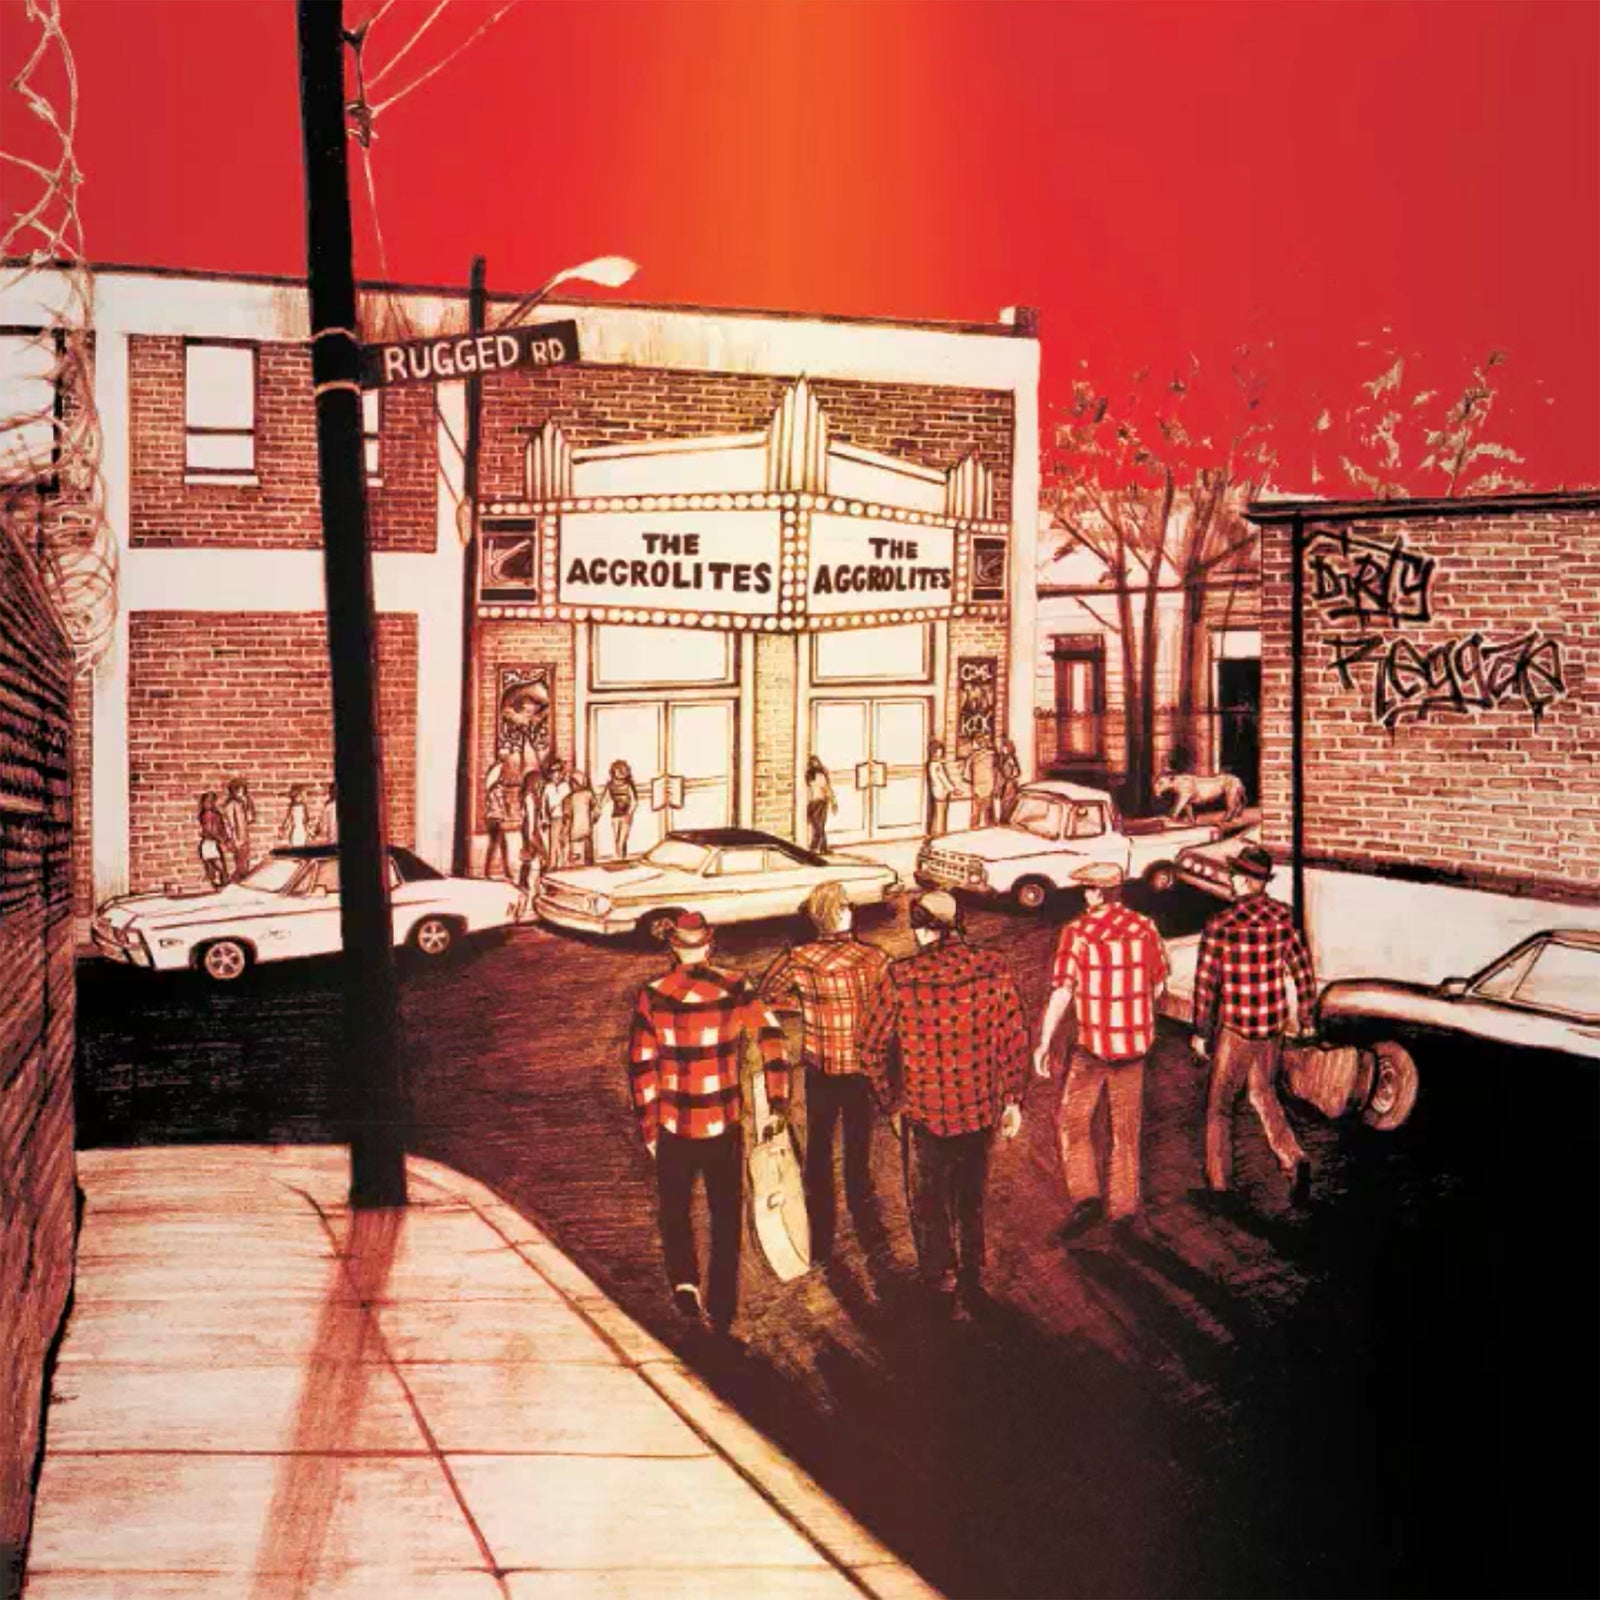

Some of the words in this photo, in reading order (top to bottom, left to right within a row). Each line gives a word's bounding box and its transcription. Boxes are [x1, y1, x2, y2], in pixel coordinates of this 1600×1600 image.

[385, 335, 518, 381] RUGGED
[531, 338, 565, 364] RD
[642, 533, 700, 555] THE
[868, 537, 918, 559] THE
[566, 557, 772, 594] AGGROLITES
[813, 564, 952, 594] AGGROLITES
